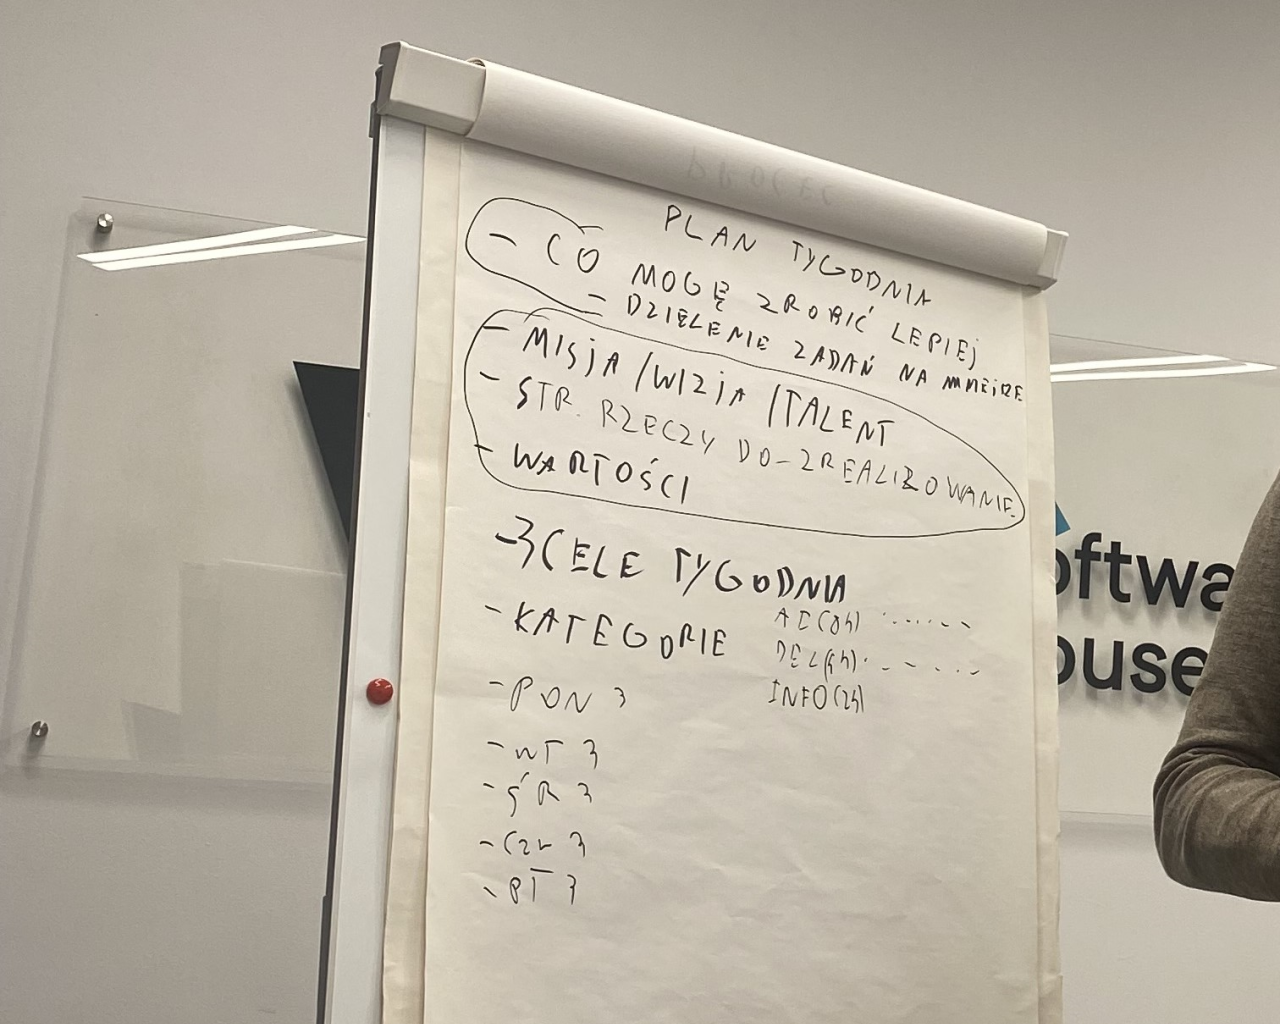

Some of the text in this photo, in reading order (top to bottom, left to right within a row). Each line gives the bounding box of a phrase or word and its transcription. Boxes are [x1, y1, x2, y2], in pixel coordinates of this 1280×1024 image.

[546, 232, 600, 273] CO
[631, 262, 730, 313] MOGĘ
[664, 204, 932, 305] PLAN TYGODNIA
[899, 363, 928, 387] NA
[601, 398, 716, 455] RZECZY
[513, 443, 689, 505] WARTOŚCI
[674, 547, 847, 604] TYGODNIA
[513, 601, 727, 660] KATEGORIE
[510, 675, 593, 714] PON
[509, 867, 555, 905] PT
